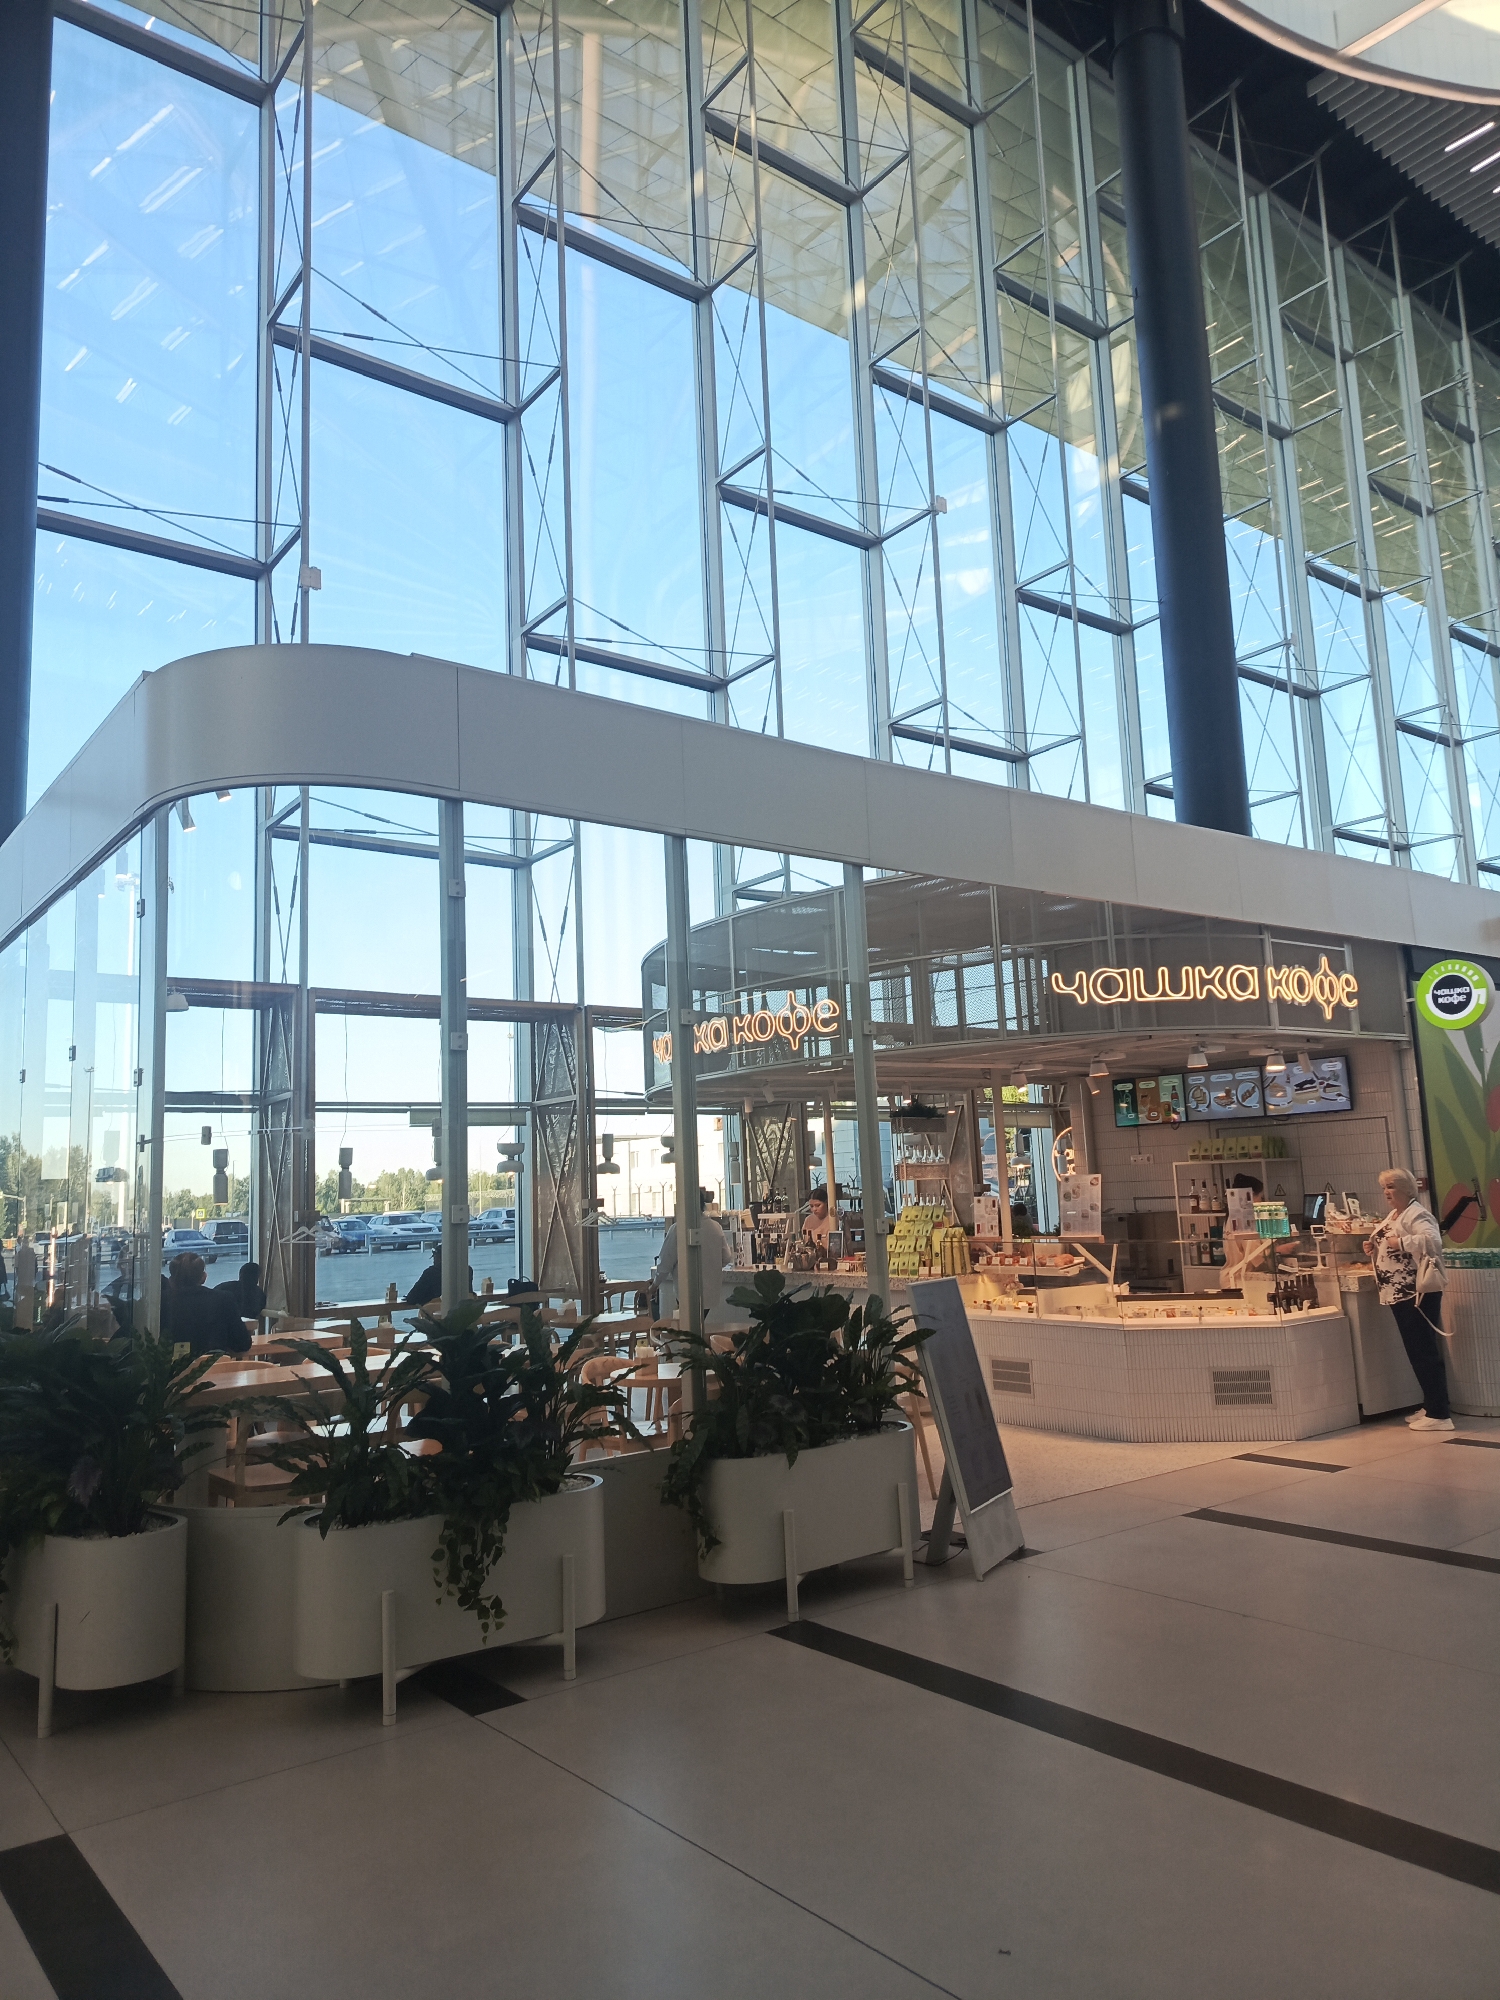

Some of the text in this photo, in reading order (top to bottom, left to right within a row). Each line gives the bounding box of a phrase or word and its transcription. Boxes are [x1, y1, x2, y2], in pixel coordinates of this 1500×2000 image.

[1051, 953, 1360, 1022] чашка кофе
[652, 990, 840, 1064] чака кофе
